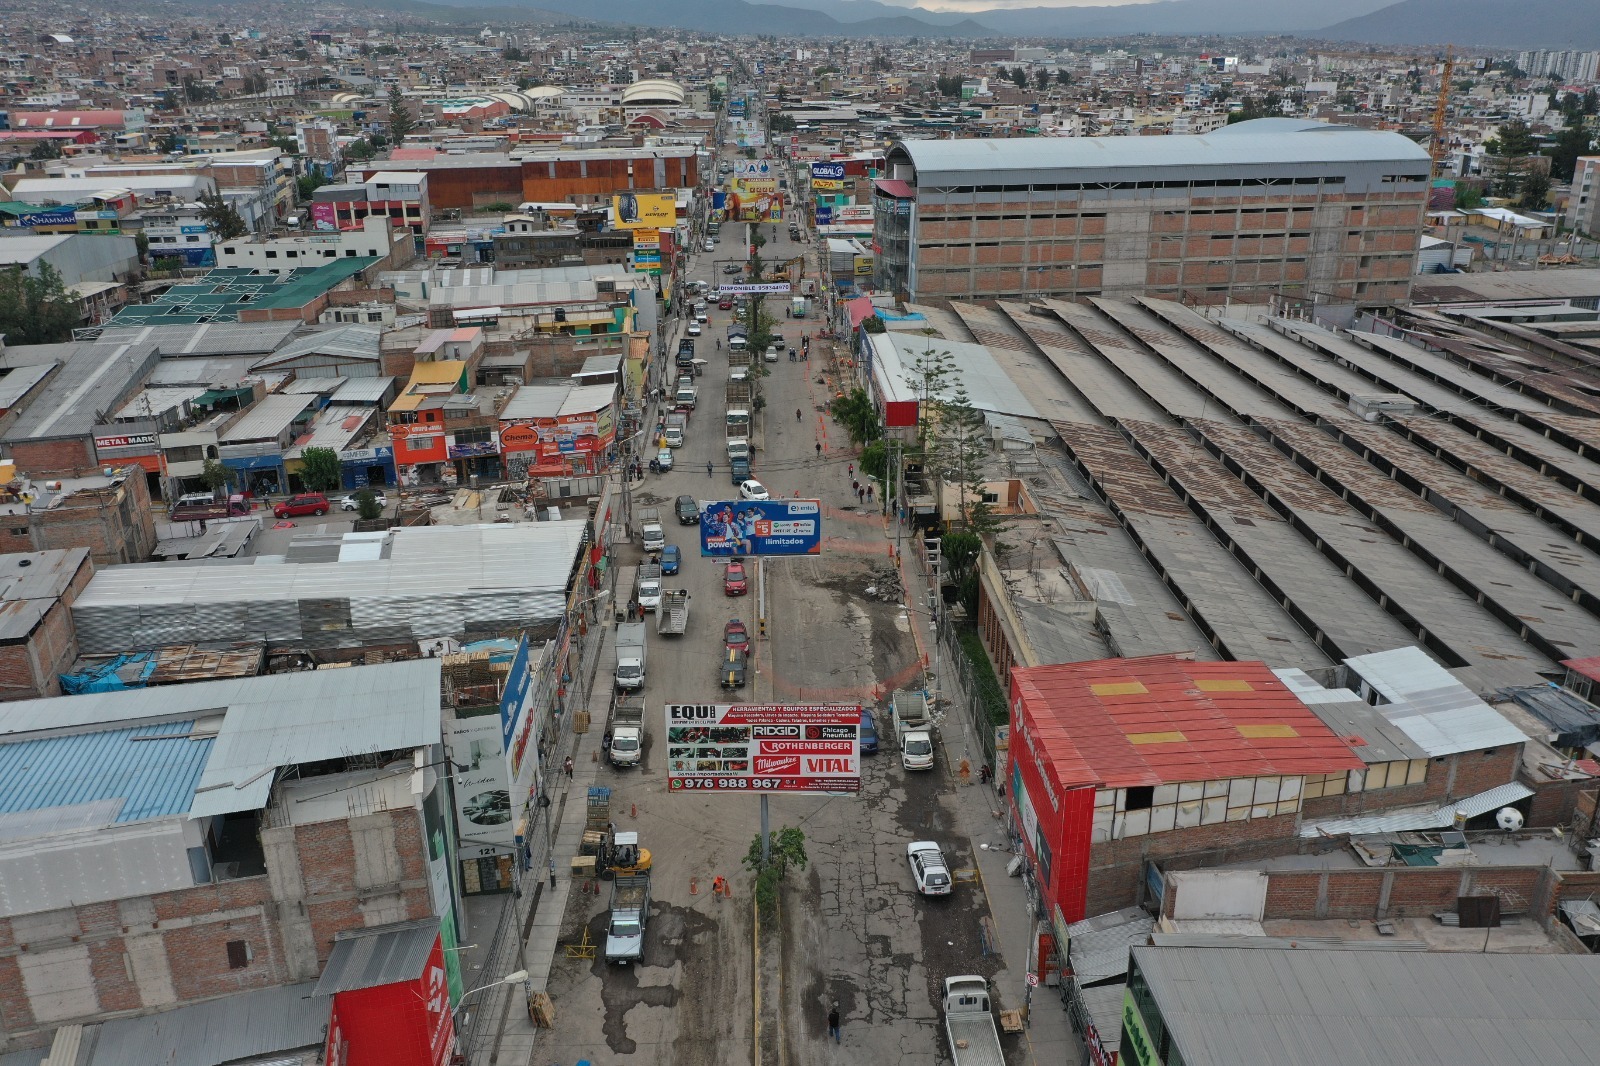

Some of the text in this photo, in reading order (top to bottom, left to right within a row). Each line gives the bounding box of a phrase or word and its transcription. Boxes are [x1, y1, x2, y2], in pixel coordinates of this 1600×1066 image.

[31, 216, 75, 225] SHAMMAH
[97, 436, 154, 446] METAL MARK
[761, 525, 768, 533] 5
[754, 727, 798, 735] RIDGID
[756, 756, 797, 770] Milwaukee
[807, 759, 853, 772] VITAL
[684, 779, 781, 788] 976 988 967
